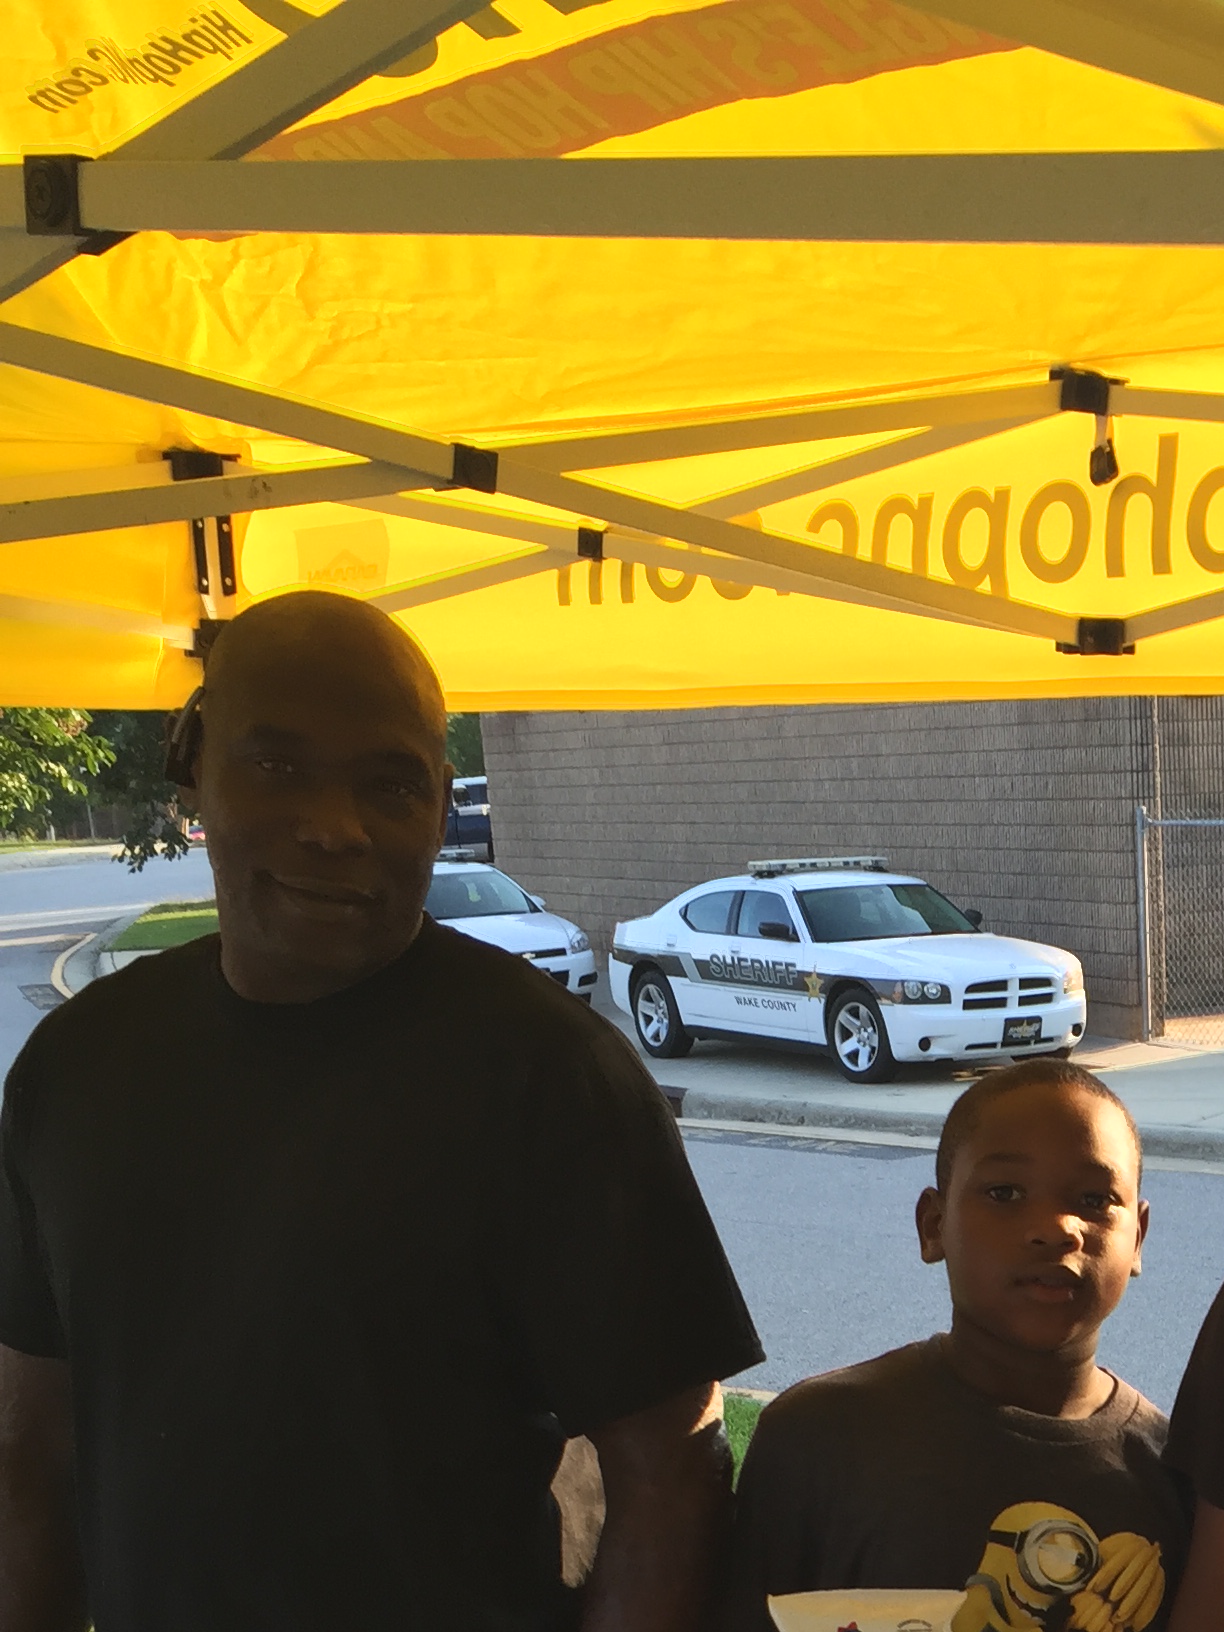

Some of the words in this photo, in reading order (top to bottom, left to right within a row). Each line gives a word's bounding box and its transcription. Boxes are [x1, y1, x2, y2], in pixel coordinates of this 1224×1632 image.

[709, 953, 798, 985] SHERIFF
[734, 995, 760, 1008] WAKE
[761, 999, 797, 1012] COUNTY
